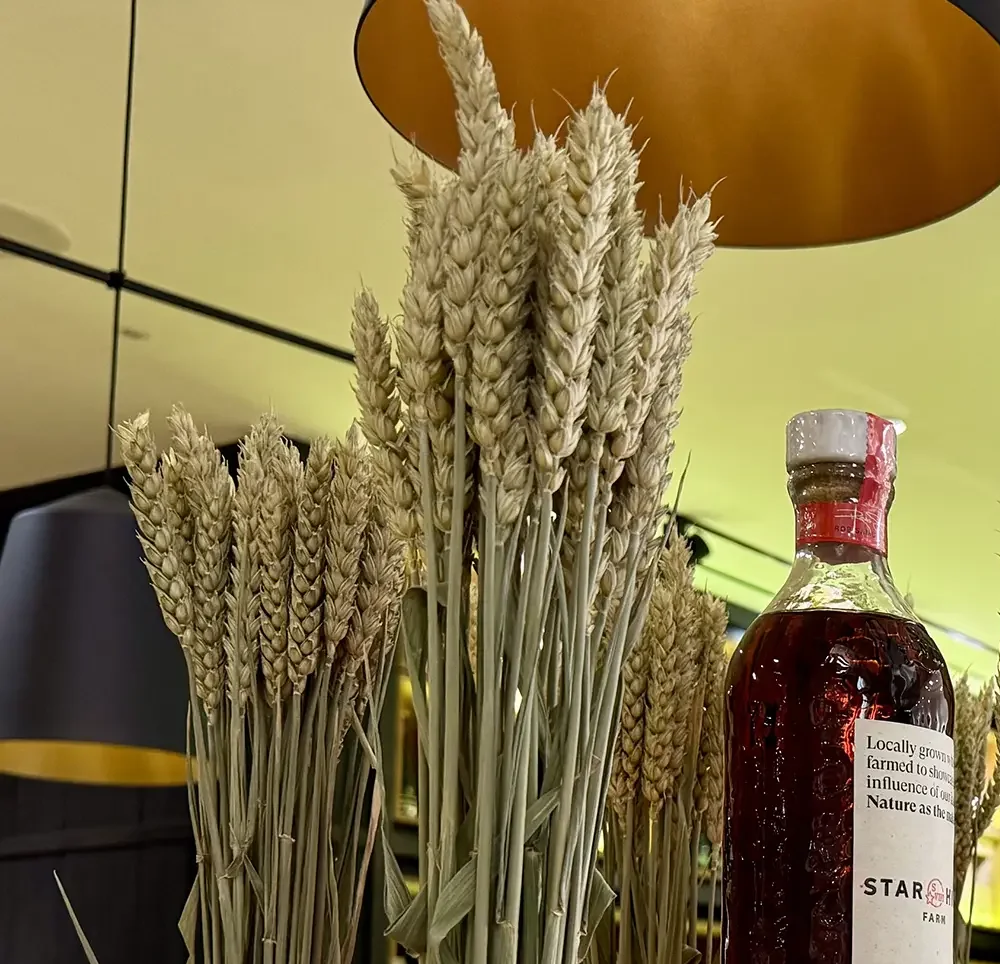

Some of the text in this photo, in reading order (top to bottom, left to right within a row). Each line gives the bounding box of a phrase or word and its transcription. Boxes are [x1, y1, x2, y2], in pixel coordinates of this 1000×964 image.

[867, 735, 917, 757] Locally
[919, 746, 946, 763] grown
[867, 755, 913, 774] farmed
[917, 763, 927, 777] to
[867, 775, 928, 796] influence
[930, 785, 940, 799] of
[867, 795, 916, 813] Nature
[919, 803, 932, 816] as
[933, 804, 946, 820] the
[863, 878, 923, 900] STAR
[922, 911, 946, 925] FARM
